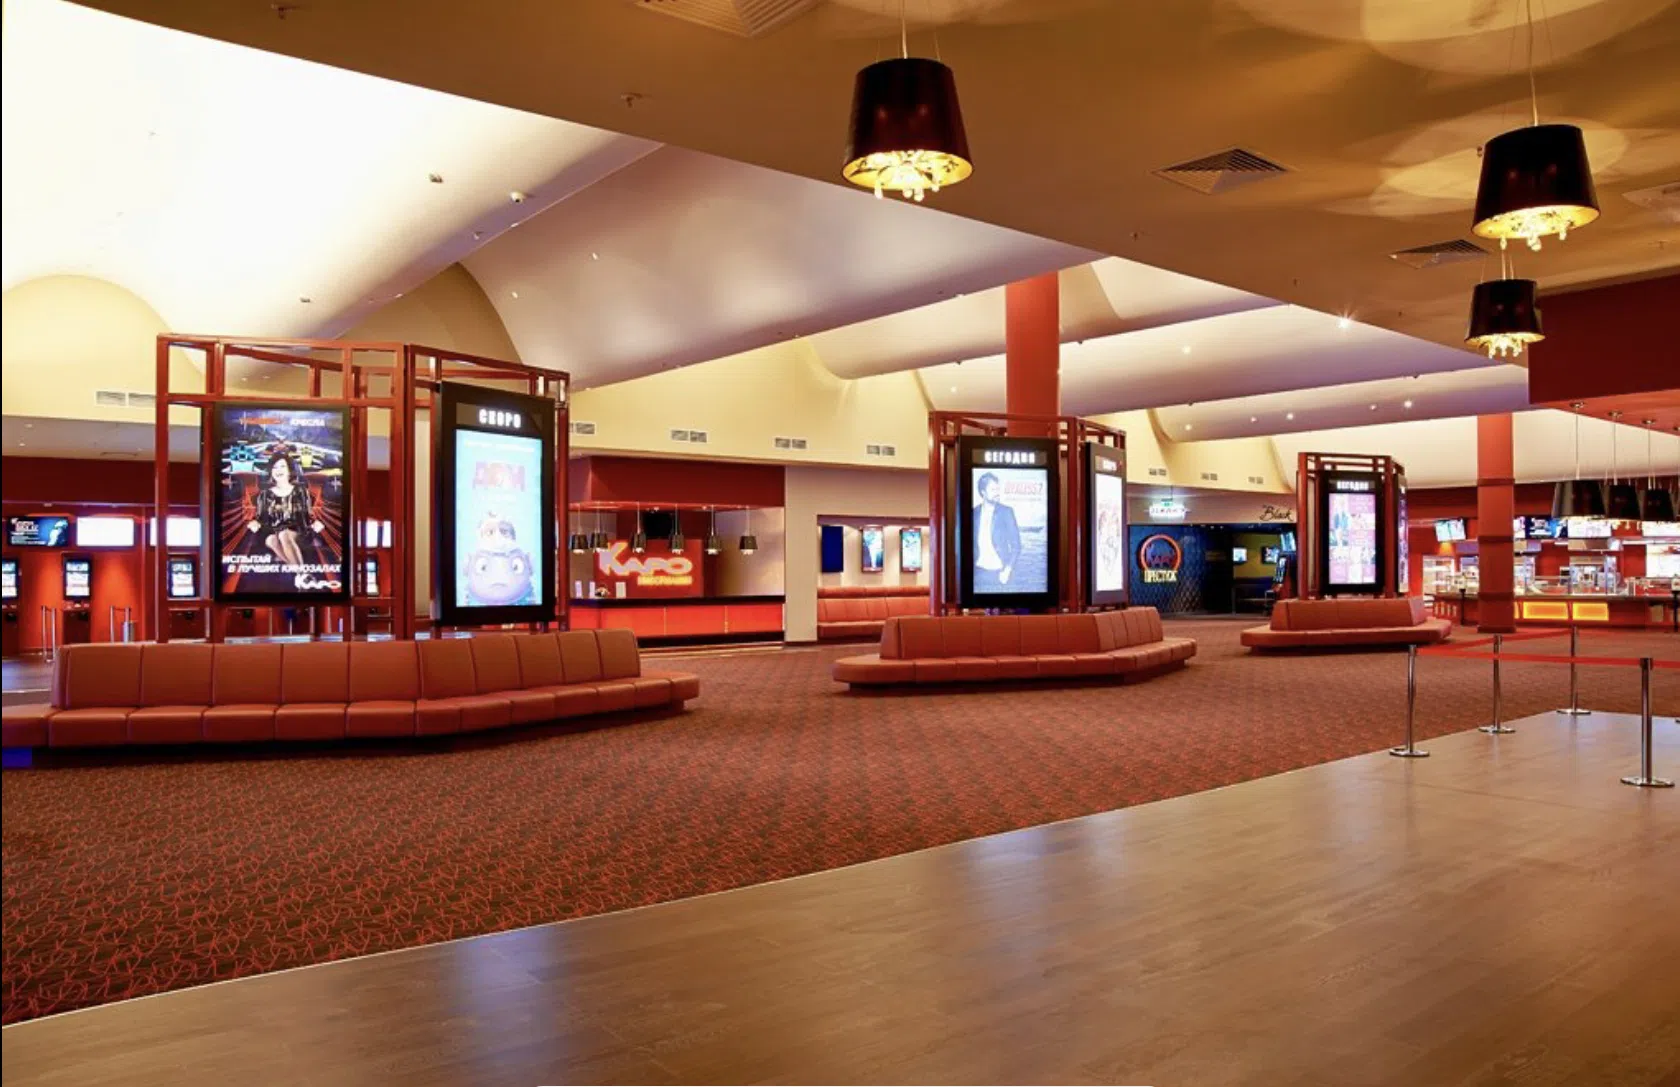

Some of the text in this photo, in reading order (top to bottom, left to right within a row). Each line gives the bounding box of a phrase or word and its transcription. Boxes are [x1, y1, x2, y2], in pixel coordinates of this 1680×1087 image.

[479, 408, 521, 428] СКОРО
[984, 451, 1035, 464] СЕГОДНЯ
[222, 554, 271, 564] ИСПЫТАЙ
[598, 541, 693, 577] КАРО
[281, 564, 341, 573] КИНОЗАЛАХ
